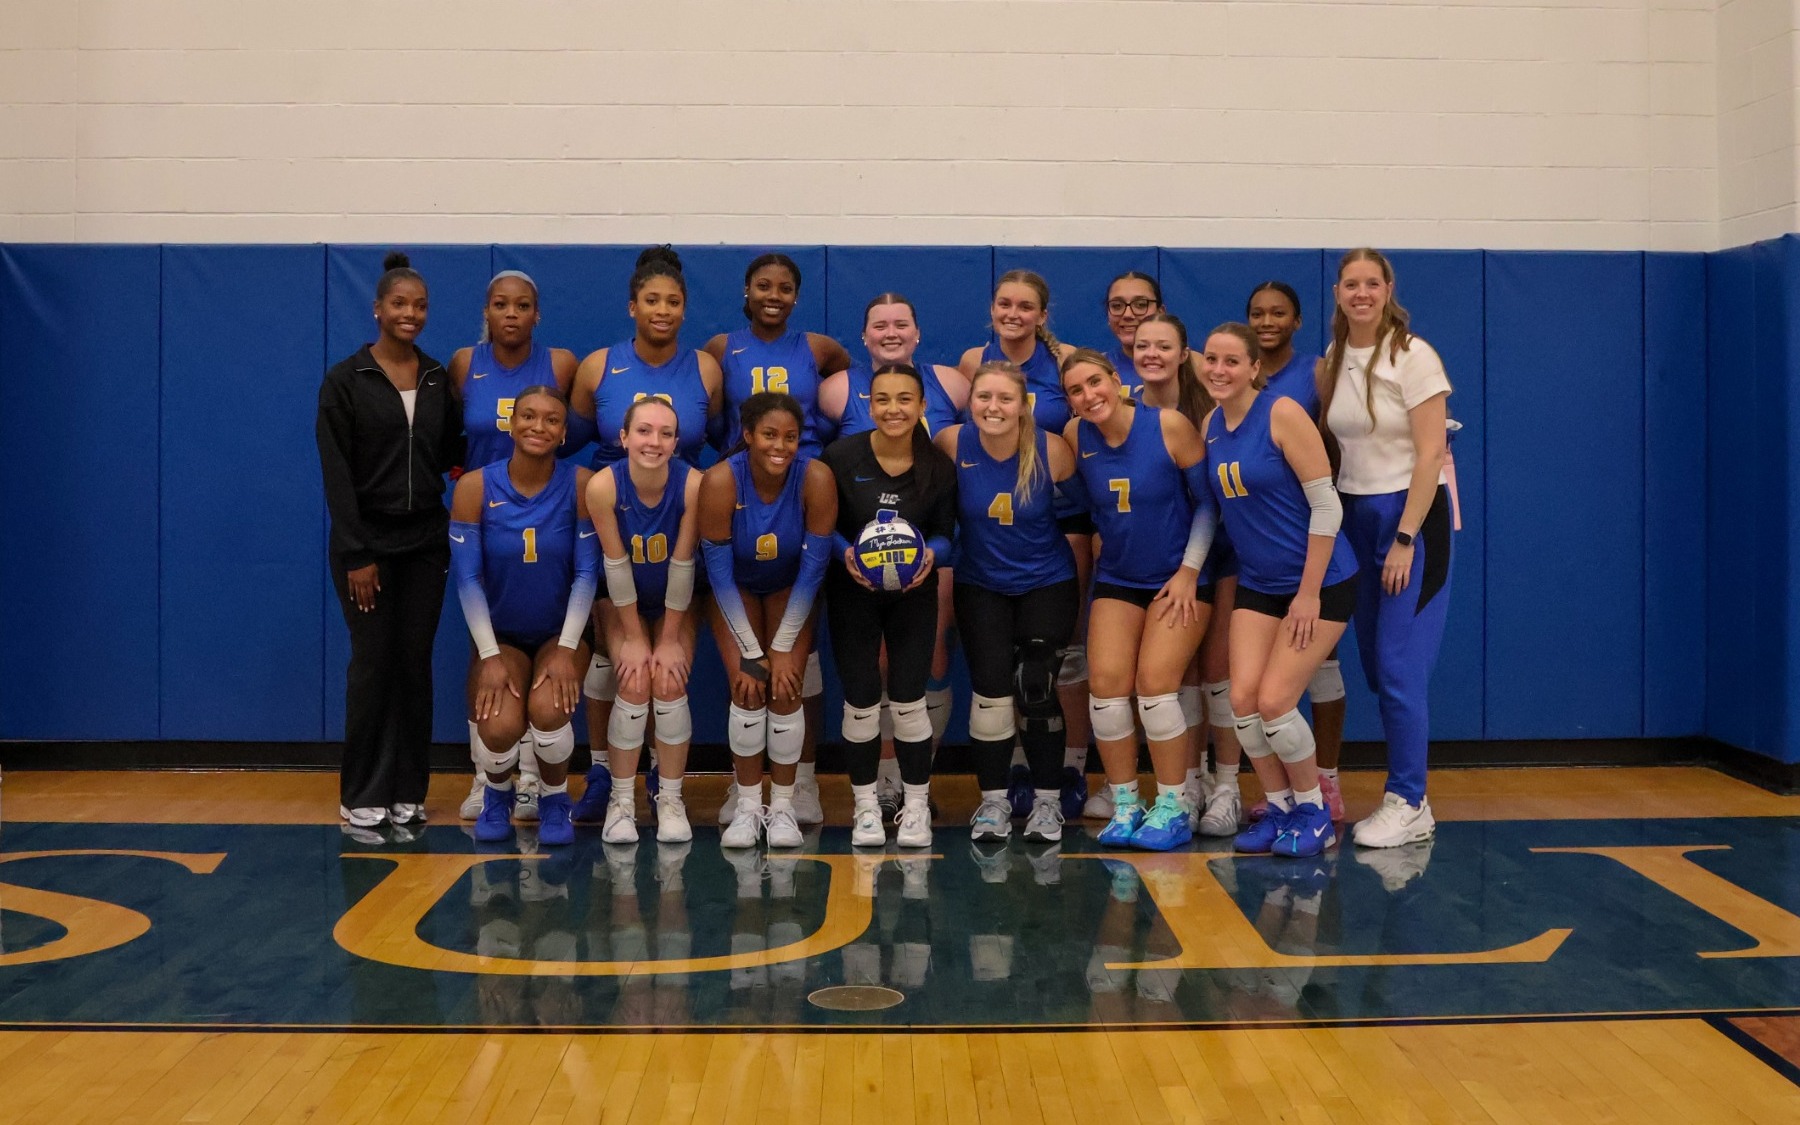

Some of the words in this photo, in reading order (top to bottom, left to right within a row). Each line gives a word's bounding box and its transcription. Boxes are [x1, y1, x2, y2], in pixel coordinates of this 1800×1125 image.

[751, 366, 789, 396] 12
[1109, 478, 1131, 513] 7
[1217, 461, 1249, 499] 11
[987, 493, 1014, 526] 4
[522, 527, 538, 563] 1
[631, 532, 668, 564] 10
[755, 533, 778, 562] 9
